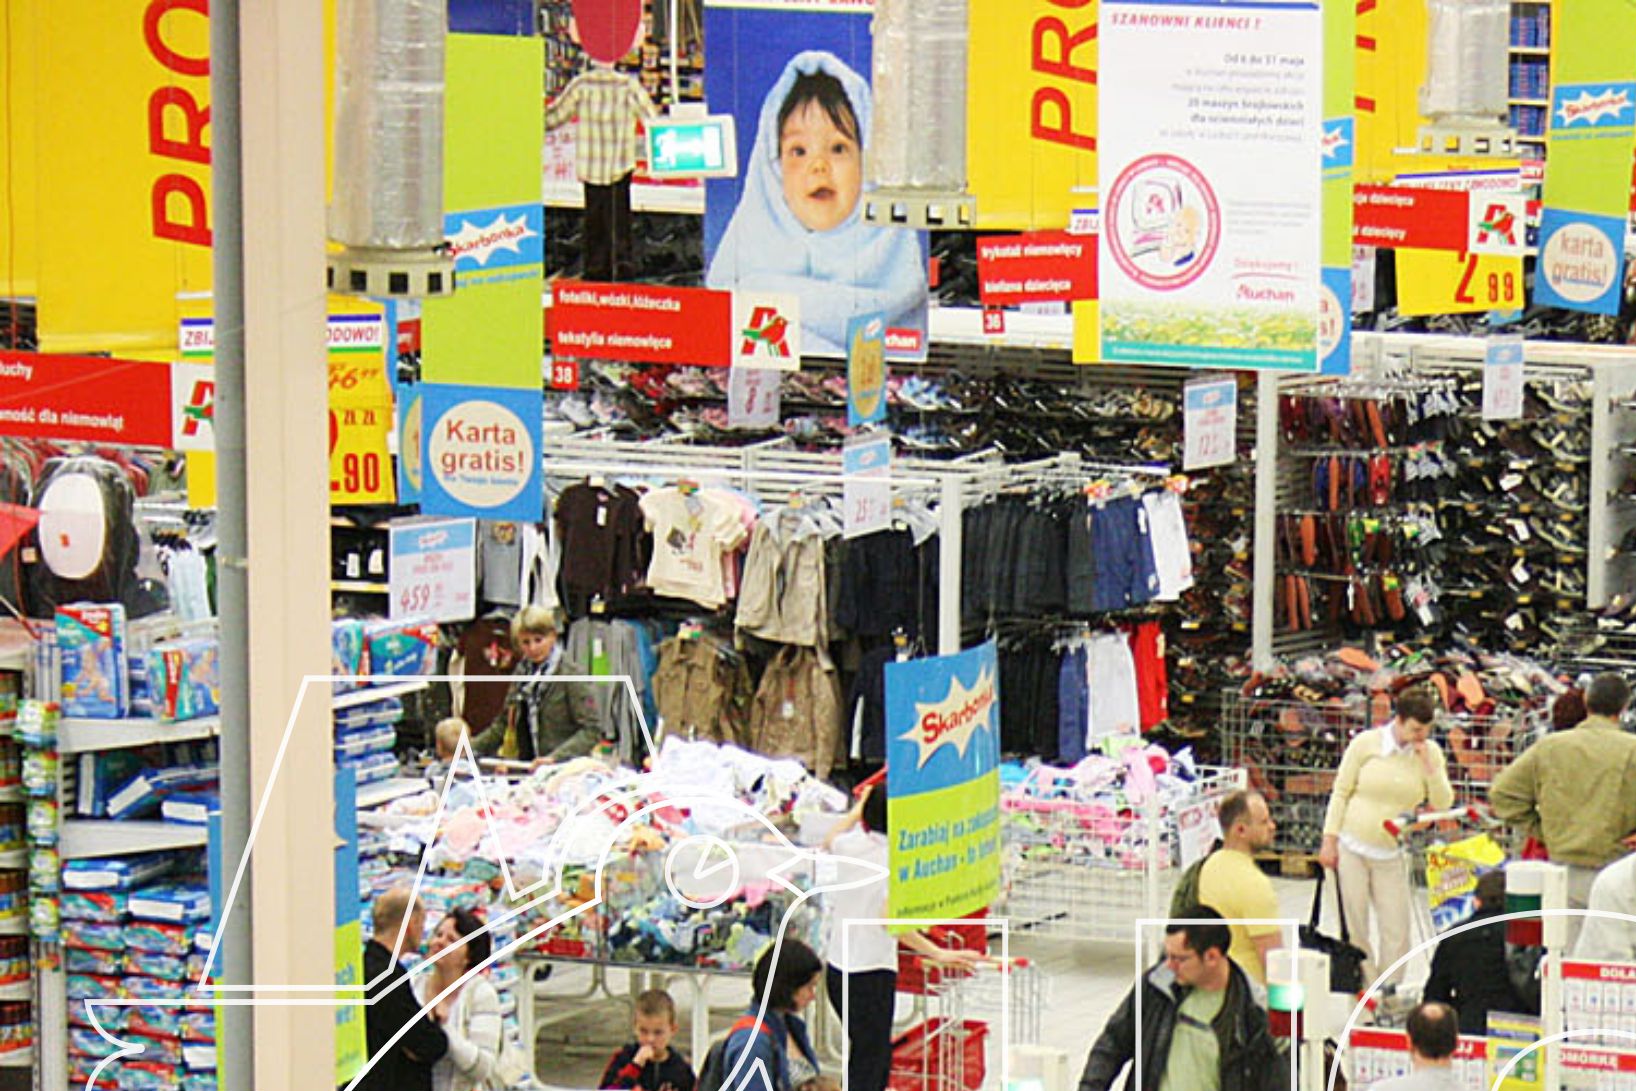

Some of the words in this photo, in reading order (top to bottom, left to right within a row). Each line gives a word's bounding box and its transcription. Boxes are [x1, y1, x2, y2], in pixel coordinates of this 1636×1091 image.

[1111, 13, 1190, 27] SZANOWNI
[1195, 15, 1250, 29] KLIENCI
[1236, 282, 1296, 304] Auchan
[184, 330, 213, 346] ZBI
[38, 409, 58, 425] dla
[61, 410, 124, 433] niemowląt
[446, 419, 517, 447] Karta
[440, 447, 526, 476] gratis!
[898, 819, 950, 851] Zarabiaj
[899, 865, 909, 882] w
[913, 850, 958, 881] Auchan
